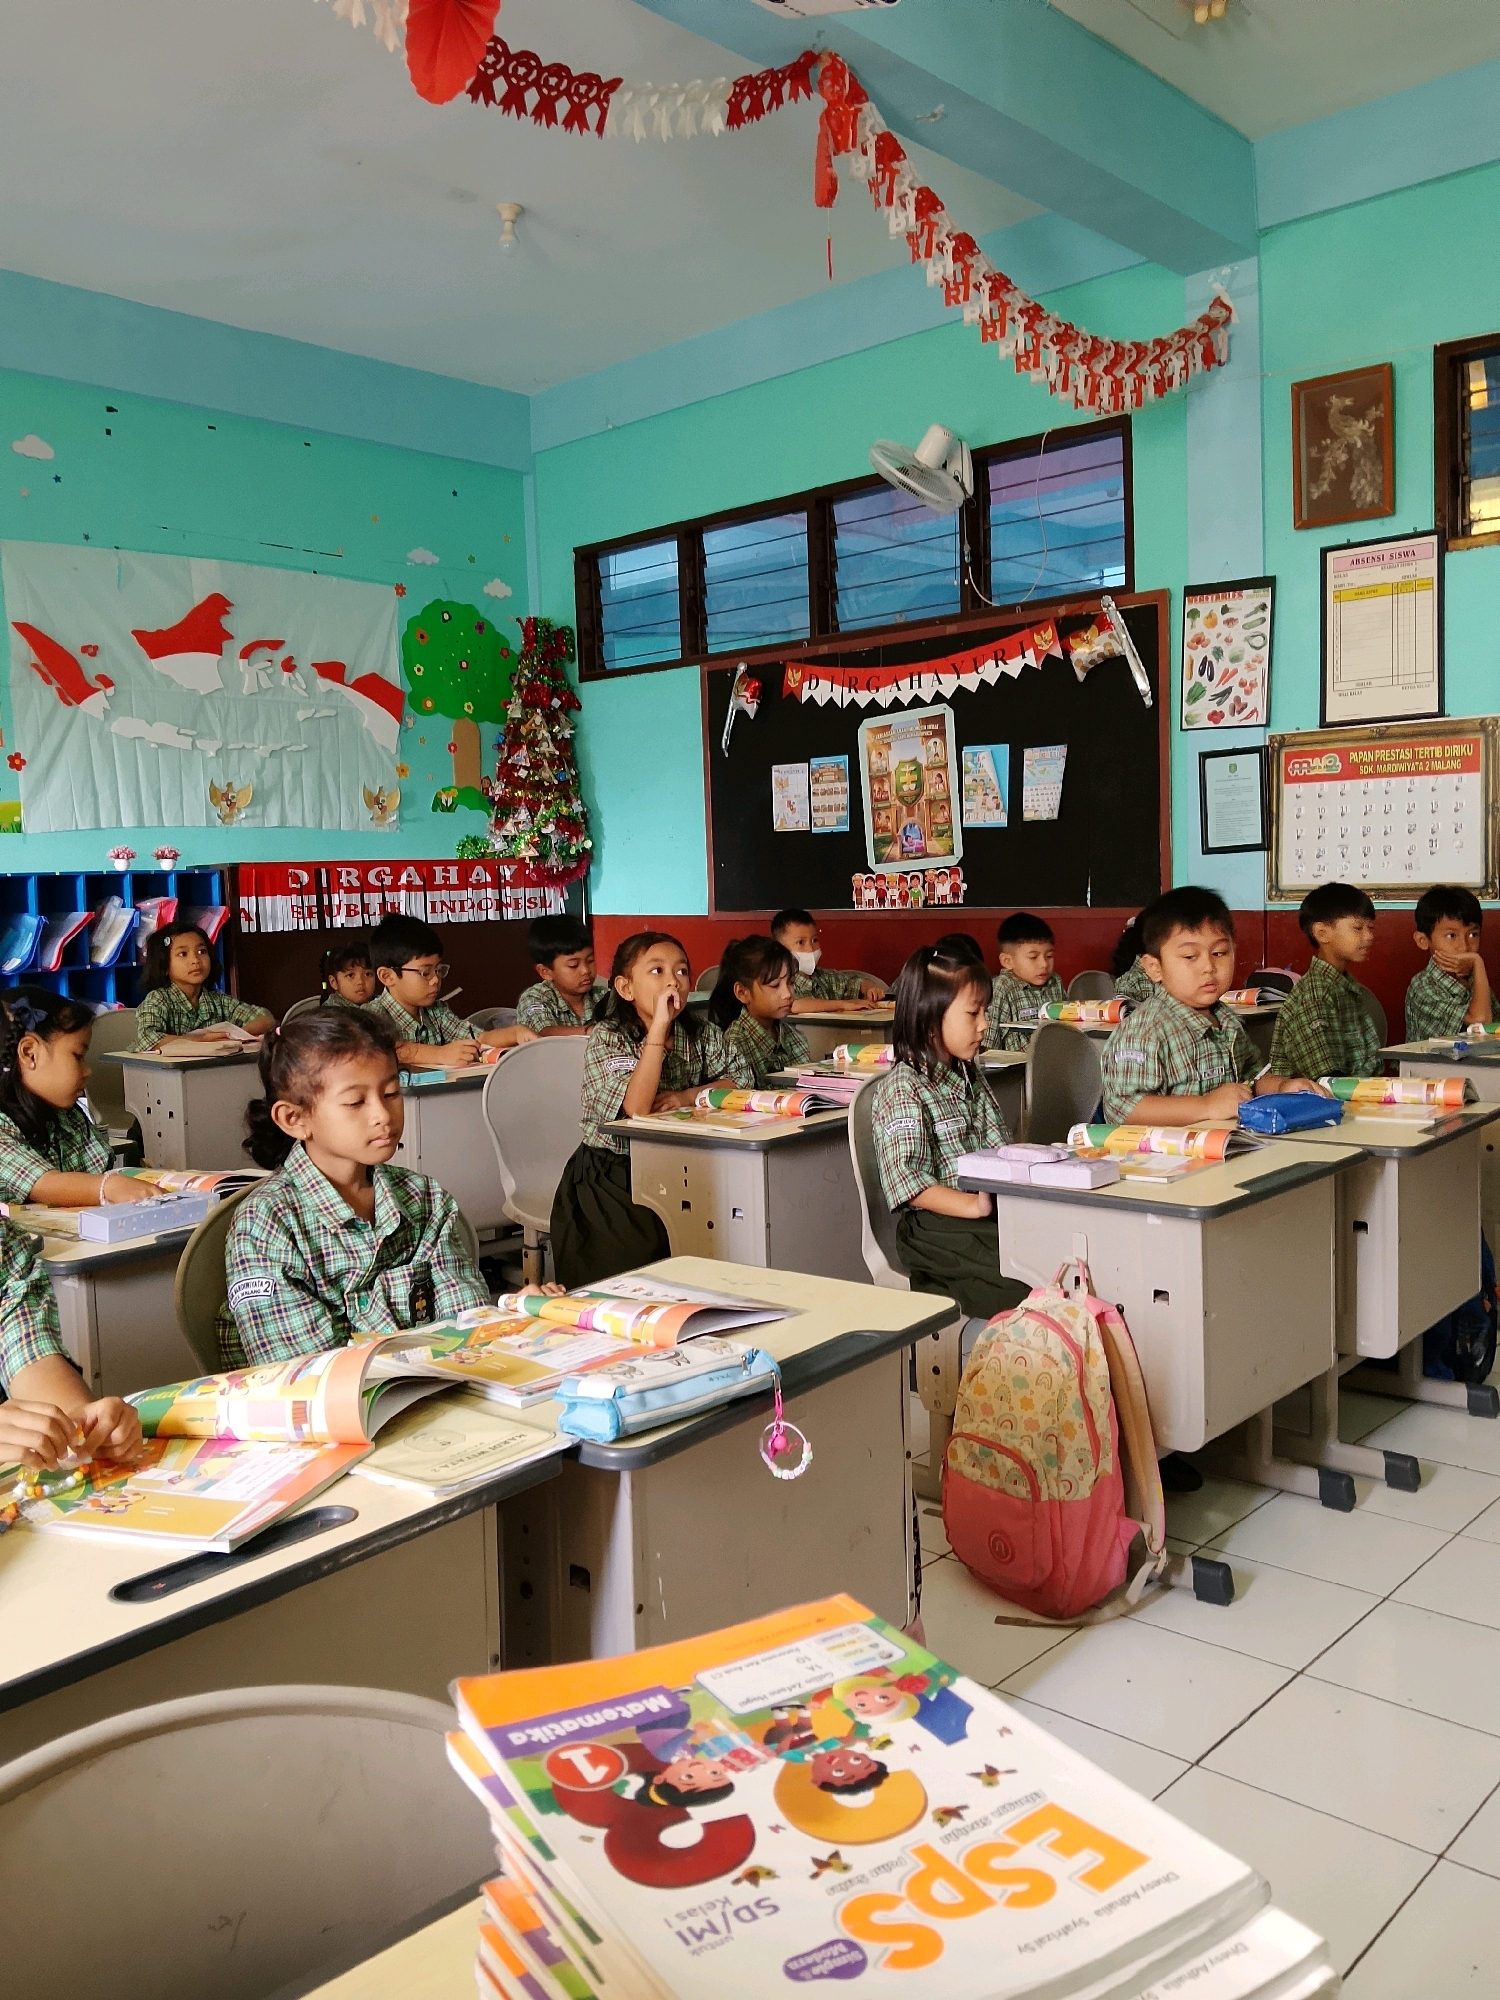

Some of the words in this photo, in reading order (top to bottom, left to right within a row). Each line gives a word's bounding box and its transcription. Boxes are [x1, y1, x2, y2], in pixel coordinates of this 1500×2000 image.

[1349, 553, 1385, 567] ABSENSI
[1389, 549, 1416, 560] SISWA
[1349, 750, 1374, 763] PAPAN
[1375, 748, 1413, 761] PRESTASI
[1414, 745, 1442, 759] TERTIB
[1444, 743, 1473, 757] DIRIKU
[1376, 761, 1424, 774] MARDIWIYATA
[1425, 761, 1430, 771] 2
[1431, 759, 1462, 770] MALANG
[1318, 806, 1326, 814] 10
[1364, 804, 1374, 812] 12
[1406, 802, 1416, 810] 14
[1318, 826, 1326, 834] 18
[1362, 826, 1372, 834] 20
[1408, 822, 1418, 832] 22
[287, 864, 522, 889] DIRGAHAY
[263, 1280, 272, 1293] 2
[507, 1693, 673, 1746] Matematika
[558, 1747, 610, 1785] 1
[1140, 1870, 1180, 1894] Dhesy
[674, 1895, 733, 1922] Kelas
[1093, 1890, 1141, 1918] Adhalia
[674, 1896, 781, 1948] SD/MI
[688, 1933, 734, 1957] untuk
[785, 1941, 846, 1970] Modern
[1207, 1941, 1250, 1968] Dhesy
[811, 1950, 864, 1976] Simple
